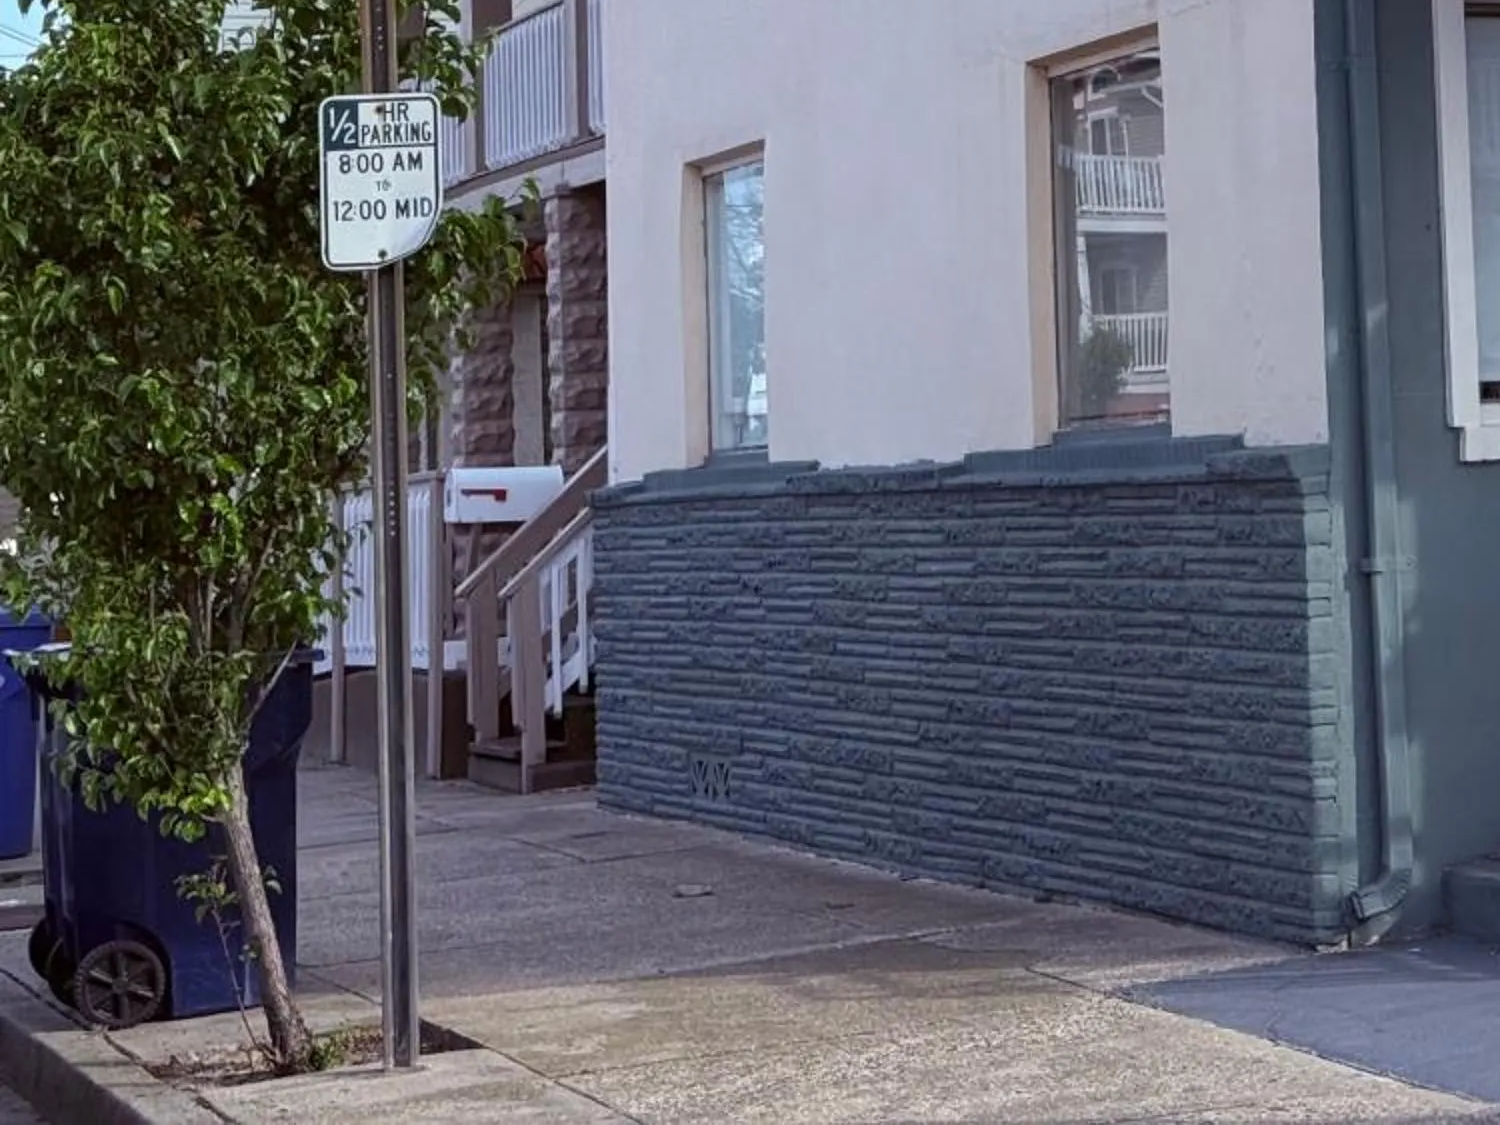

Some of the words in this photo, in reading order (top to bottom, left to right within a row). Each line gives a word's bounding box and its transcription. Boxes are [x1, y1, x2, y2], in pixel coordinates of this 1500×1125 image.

[383, 102, 409, 122] HR
[361, 121, 432, 145] PARKING
[392, 151, 423, 171] AM
[395, 197, 432, 220] MID
